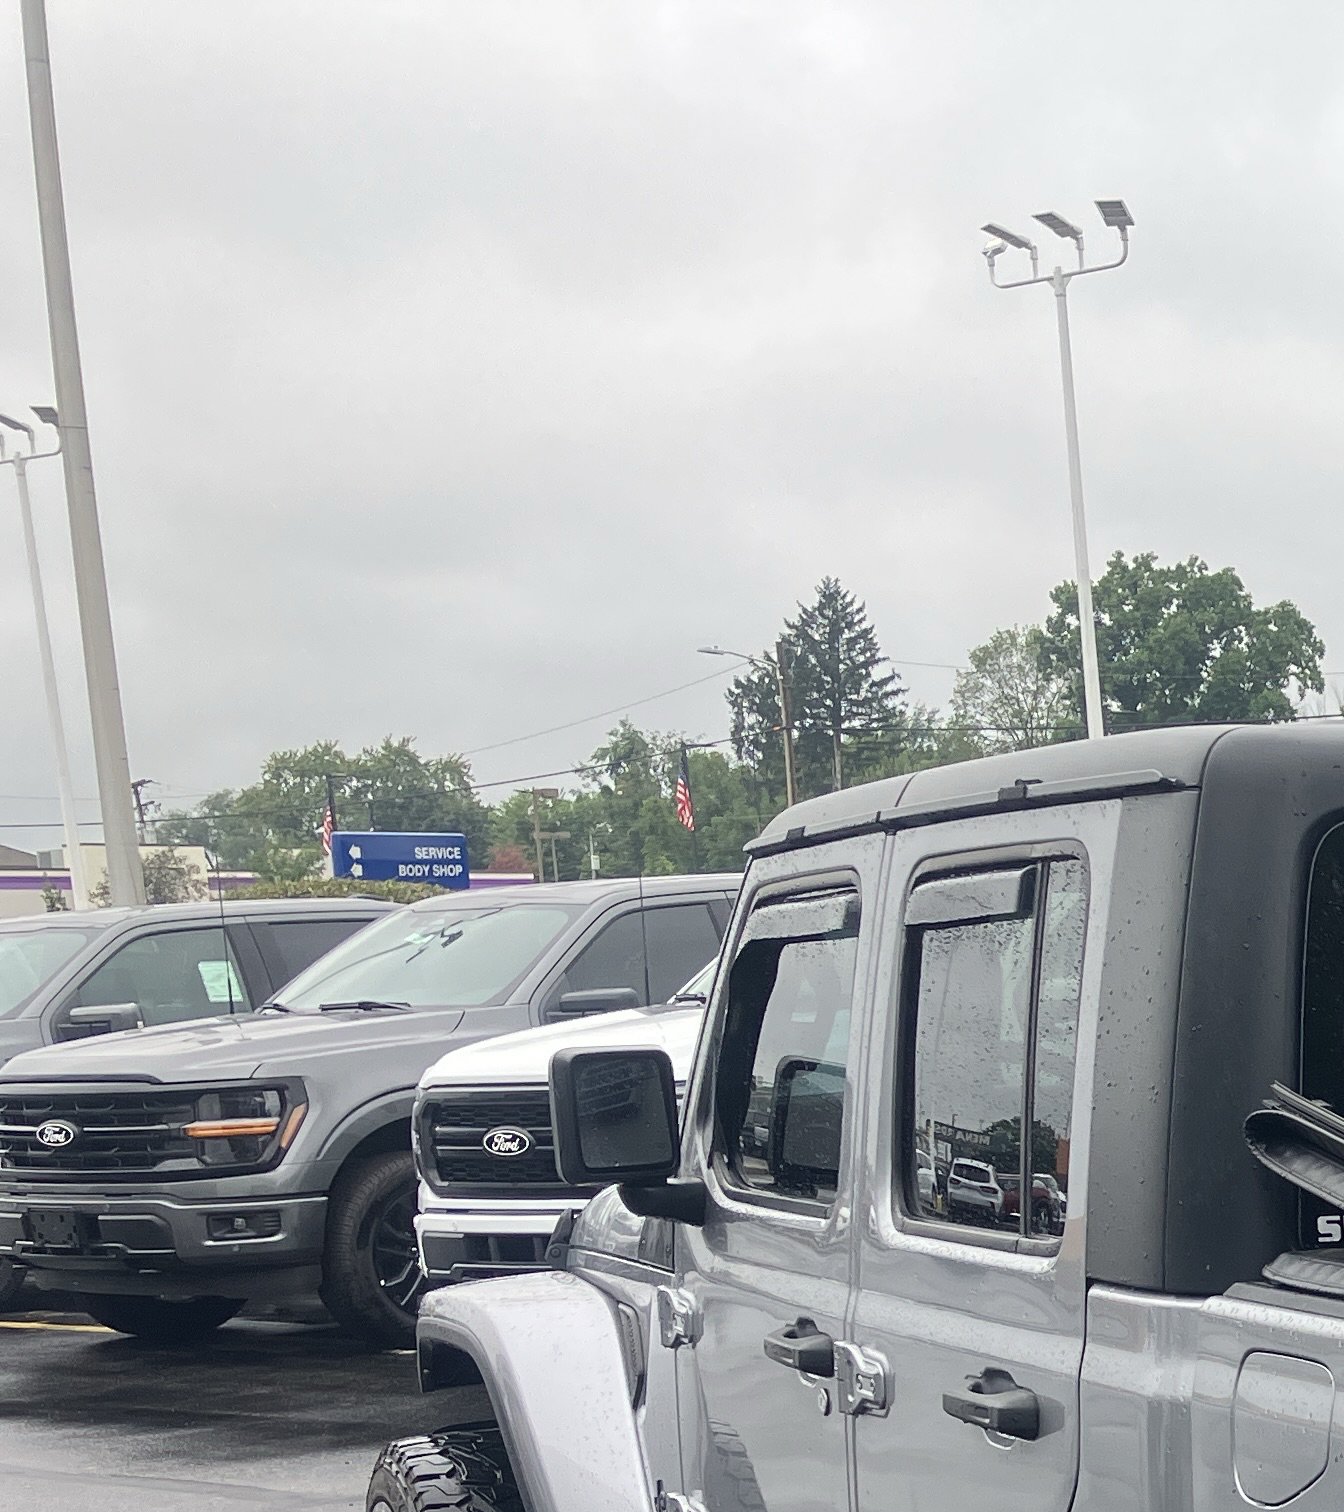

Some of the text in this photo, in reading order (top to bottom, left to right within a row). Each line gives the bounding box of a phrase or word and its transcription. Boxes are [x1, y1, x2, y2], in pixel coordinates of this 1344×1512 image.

[414, 846, 462, 859] SERVICE
[398, 864, 463, 877] BODY SHOP
[43, 1126, 66, 1142] Ford
[492, 1133, 520, 1151] Ford
